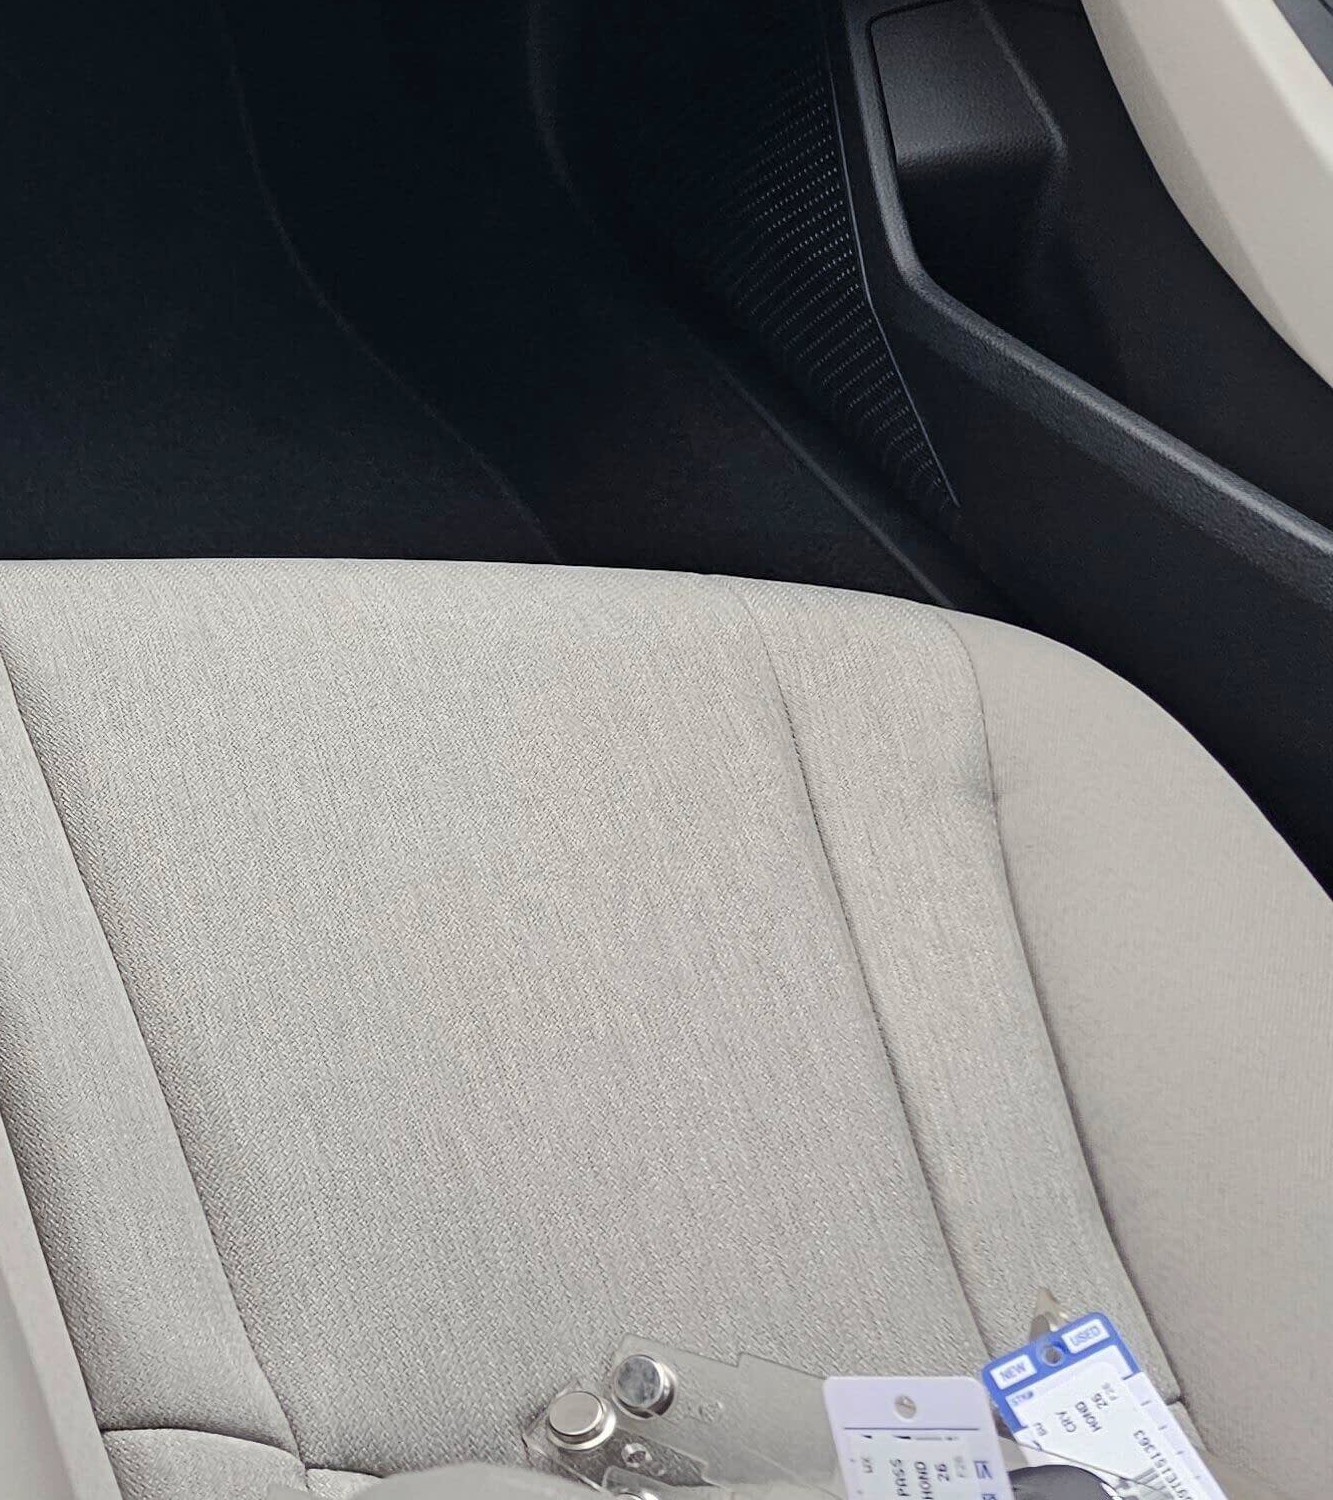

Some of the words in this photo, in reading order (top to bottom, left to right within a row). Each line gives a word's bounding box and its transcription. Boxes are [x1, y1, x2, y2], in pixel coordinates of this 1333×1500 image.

[1069, 1325, 1101, 1347] USED
[999, 1361, 1028, 1381] NEW
[1091, 1392, 1108, 1410] 26
[1056, 1410, 1077, 1433] CRV
[1074, 1400, 1102, 1433] HOND
[889, 1458, 911, 1498] PASS
[935, 1463, 951, 1482] 26
